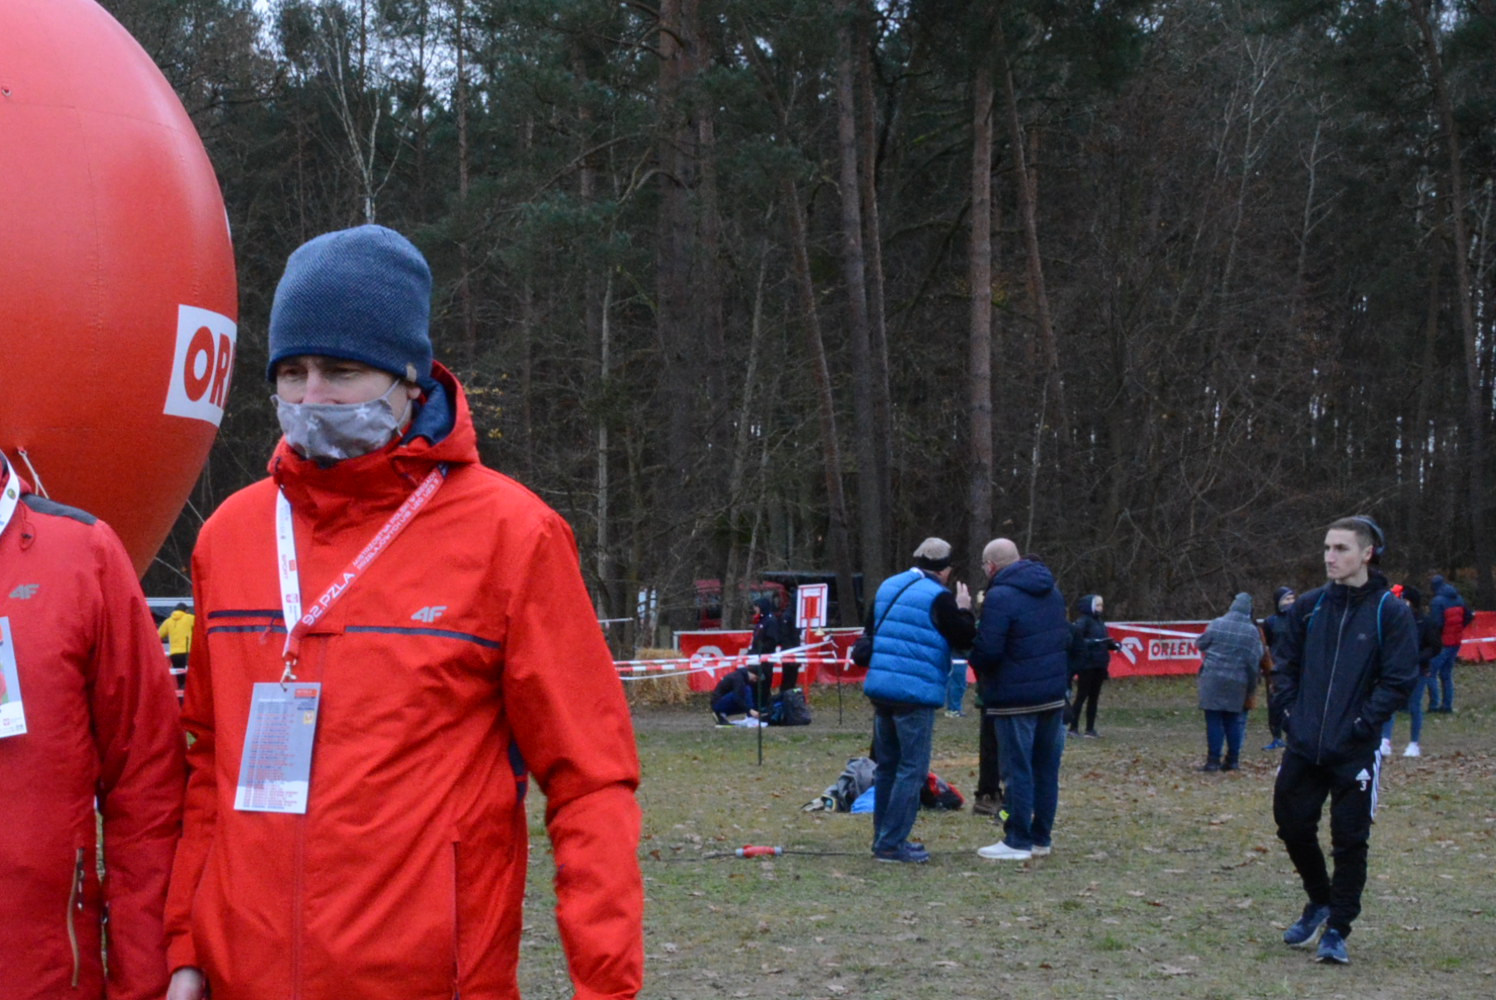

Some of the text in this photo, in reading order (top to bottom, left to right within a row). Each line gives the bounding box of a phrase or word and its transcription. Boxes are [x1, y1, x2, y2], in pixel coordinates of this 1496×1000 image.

[9, 584, 40, 599] 4F
[411, 606, 447, 622] 4F
[1151, 641, 1199, 656] ORLEN
